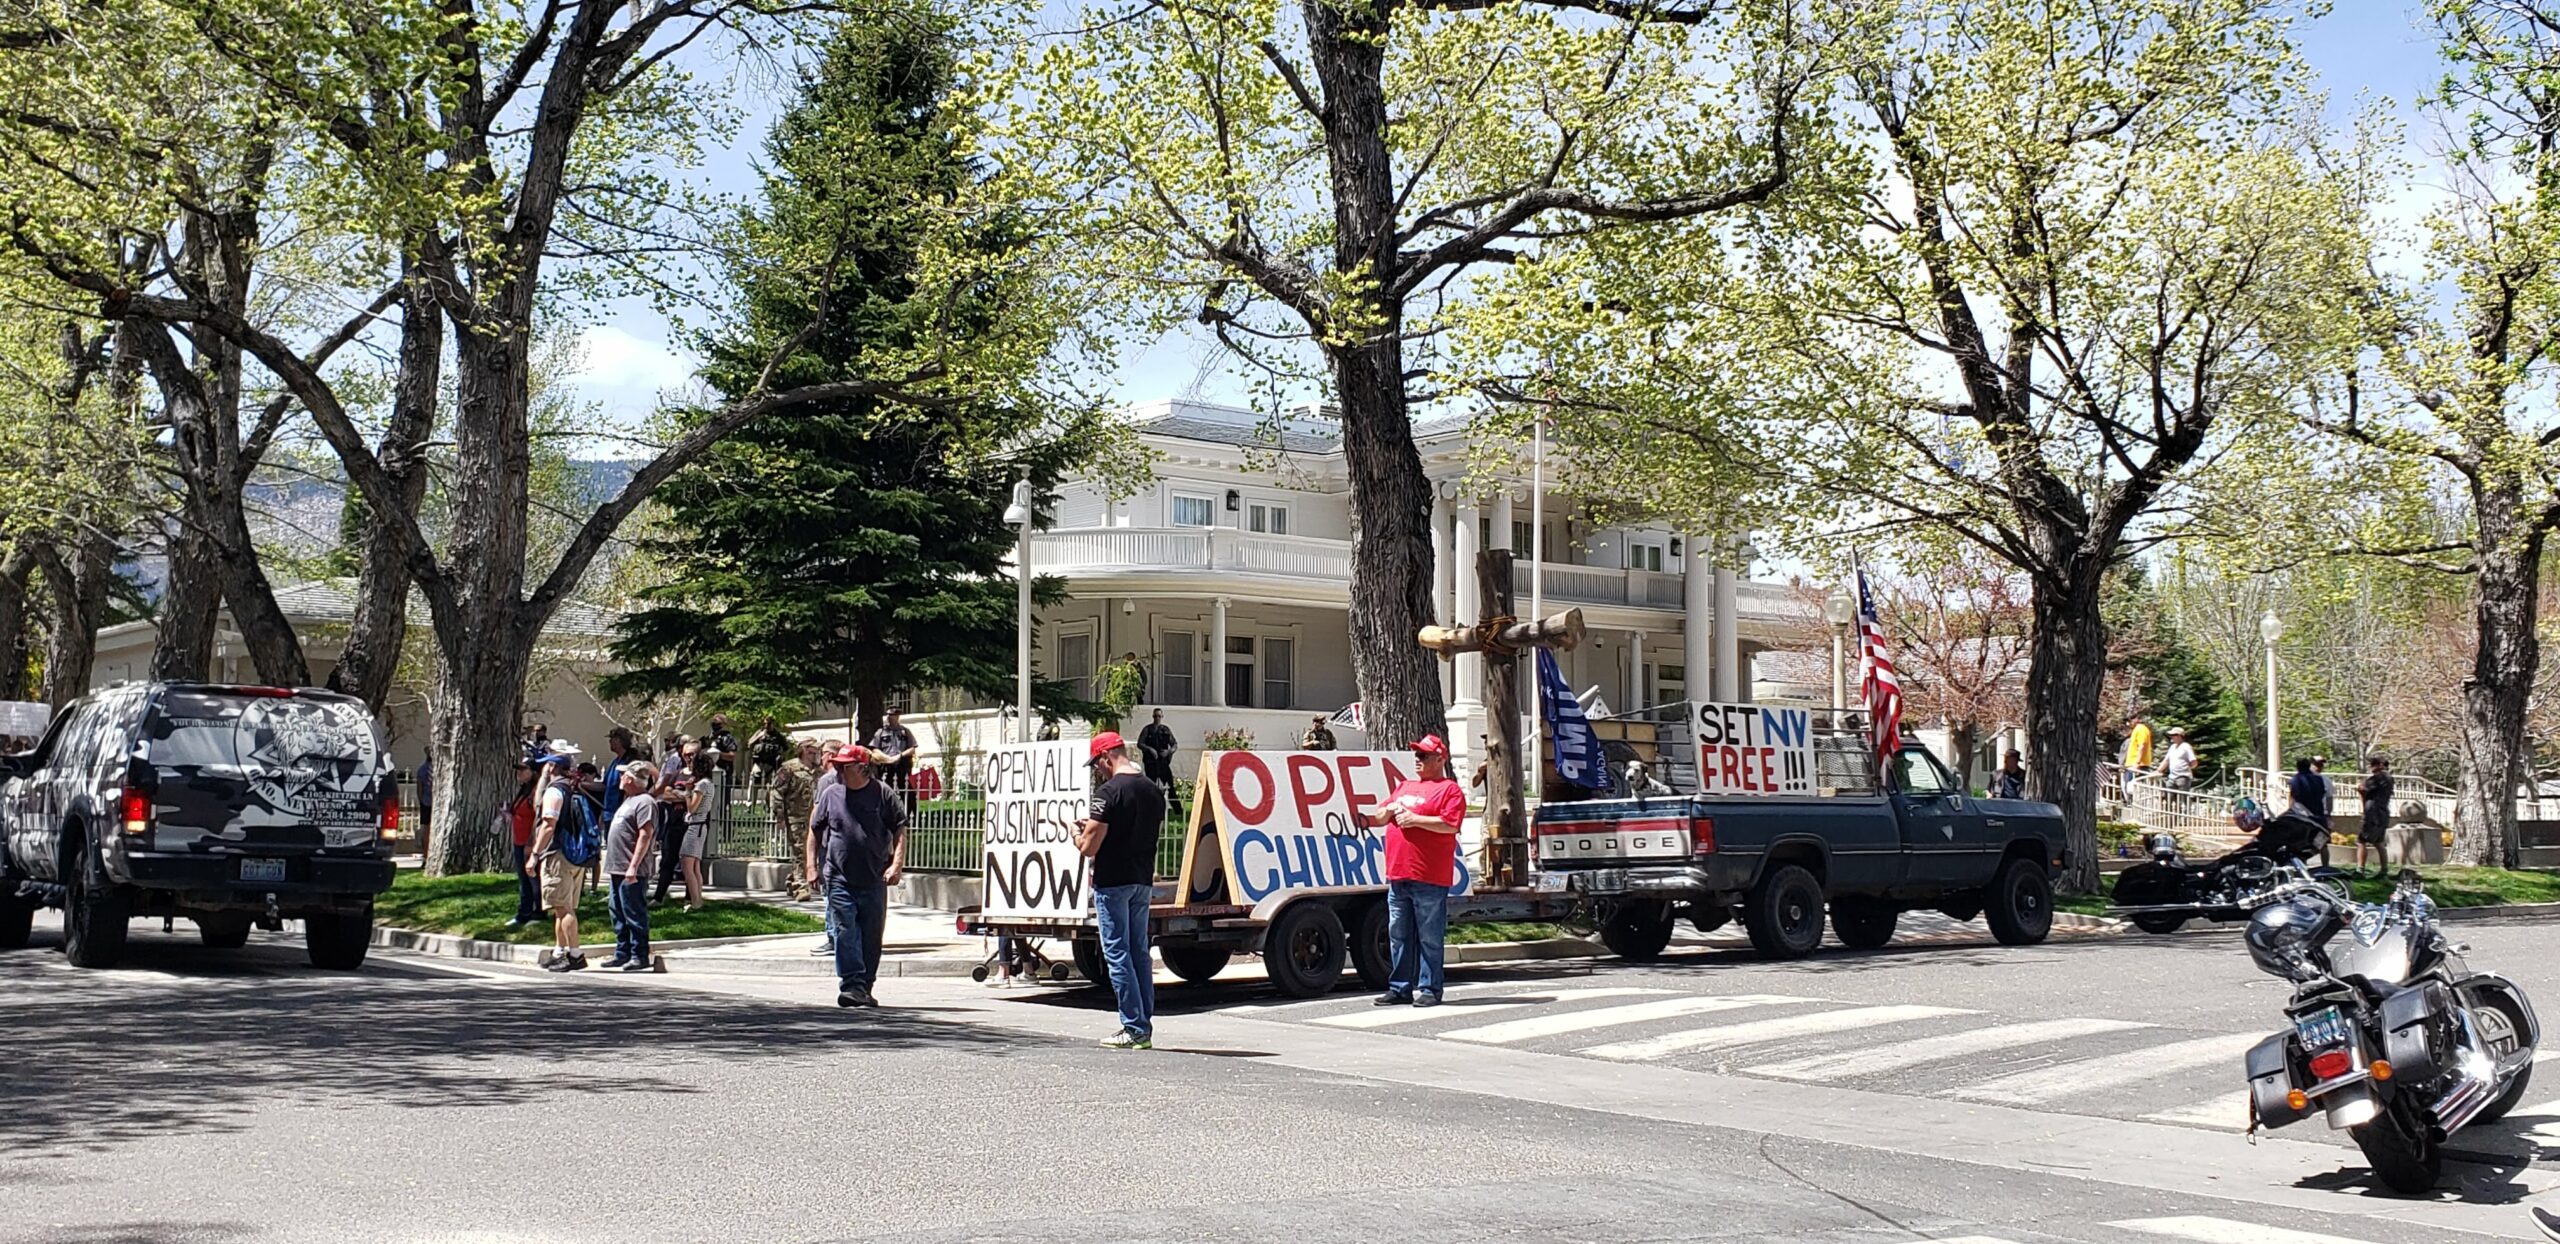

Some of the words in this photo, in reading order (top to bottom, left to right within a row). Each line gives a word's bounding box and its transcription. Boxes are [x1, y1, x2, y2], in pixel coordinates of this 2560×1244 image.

[1699, 704, 1758, 746] SET
[1761, 708, 1806, 748] NV
[987, 749, 1036, 794] OPEN
[1041, 748, 1080, 792] ALL
[1701, 744, 1778, 792] FREE
[1784, 750, 1807, 790] !!!
[1325, 811, 1377, 841] OUR
[1553, 837, 1675, 851] DODGE
[985, 850, 1085, 910] NOW
